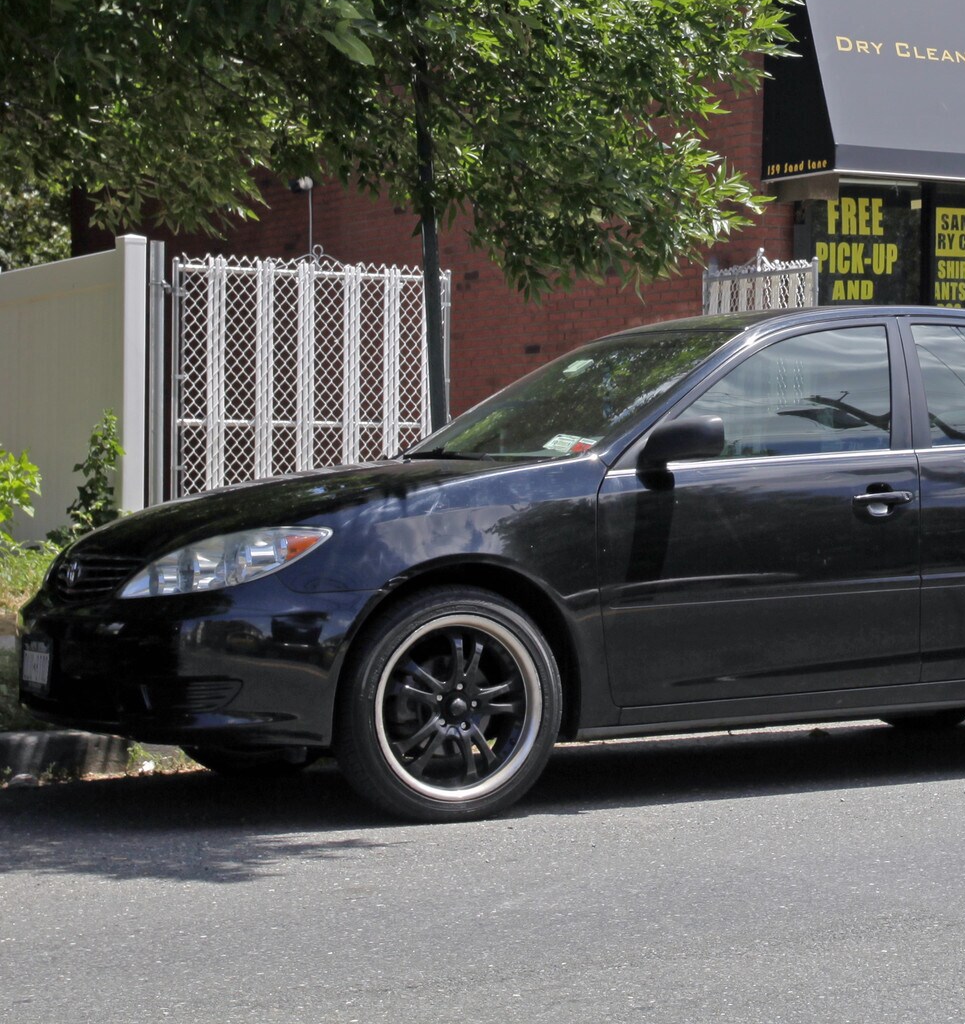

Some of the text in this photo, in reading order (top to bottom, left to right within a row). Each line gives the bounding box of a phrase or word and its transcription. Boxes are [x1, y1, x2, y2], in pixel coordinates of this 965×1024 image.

[836, 36, 883, 54] DRY
[767, 159, 828, 175] 159 Sand Lane
[826, 197, 884, 236] FREE
[937, 232, 956, 250] RY
[815, 241, 898, 275] PICK-UP
[832, 280, 874, 301] AND
